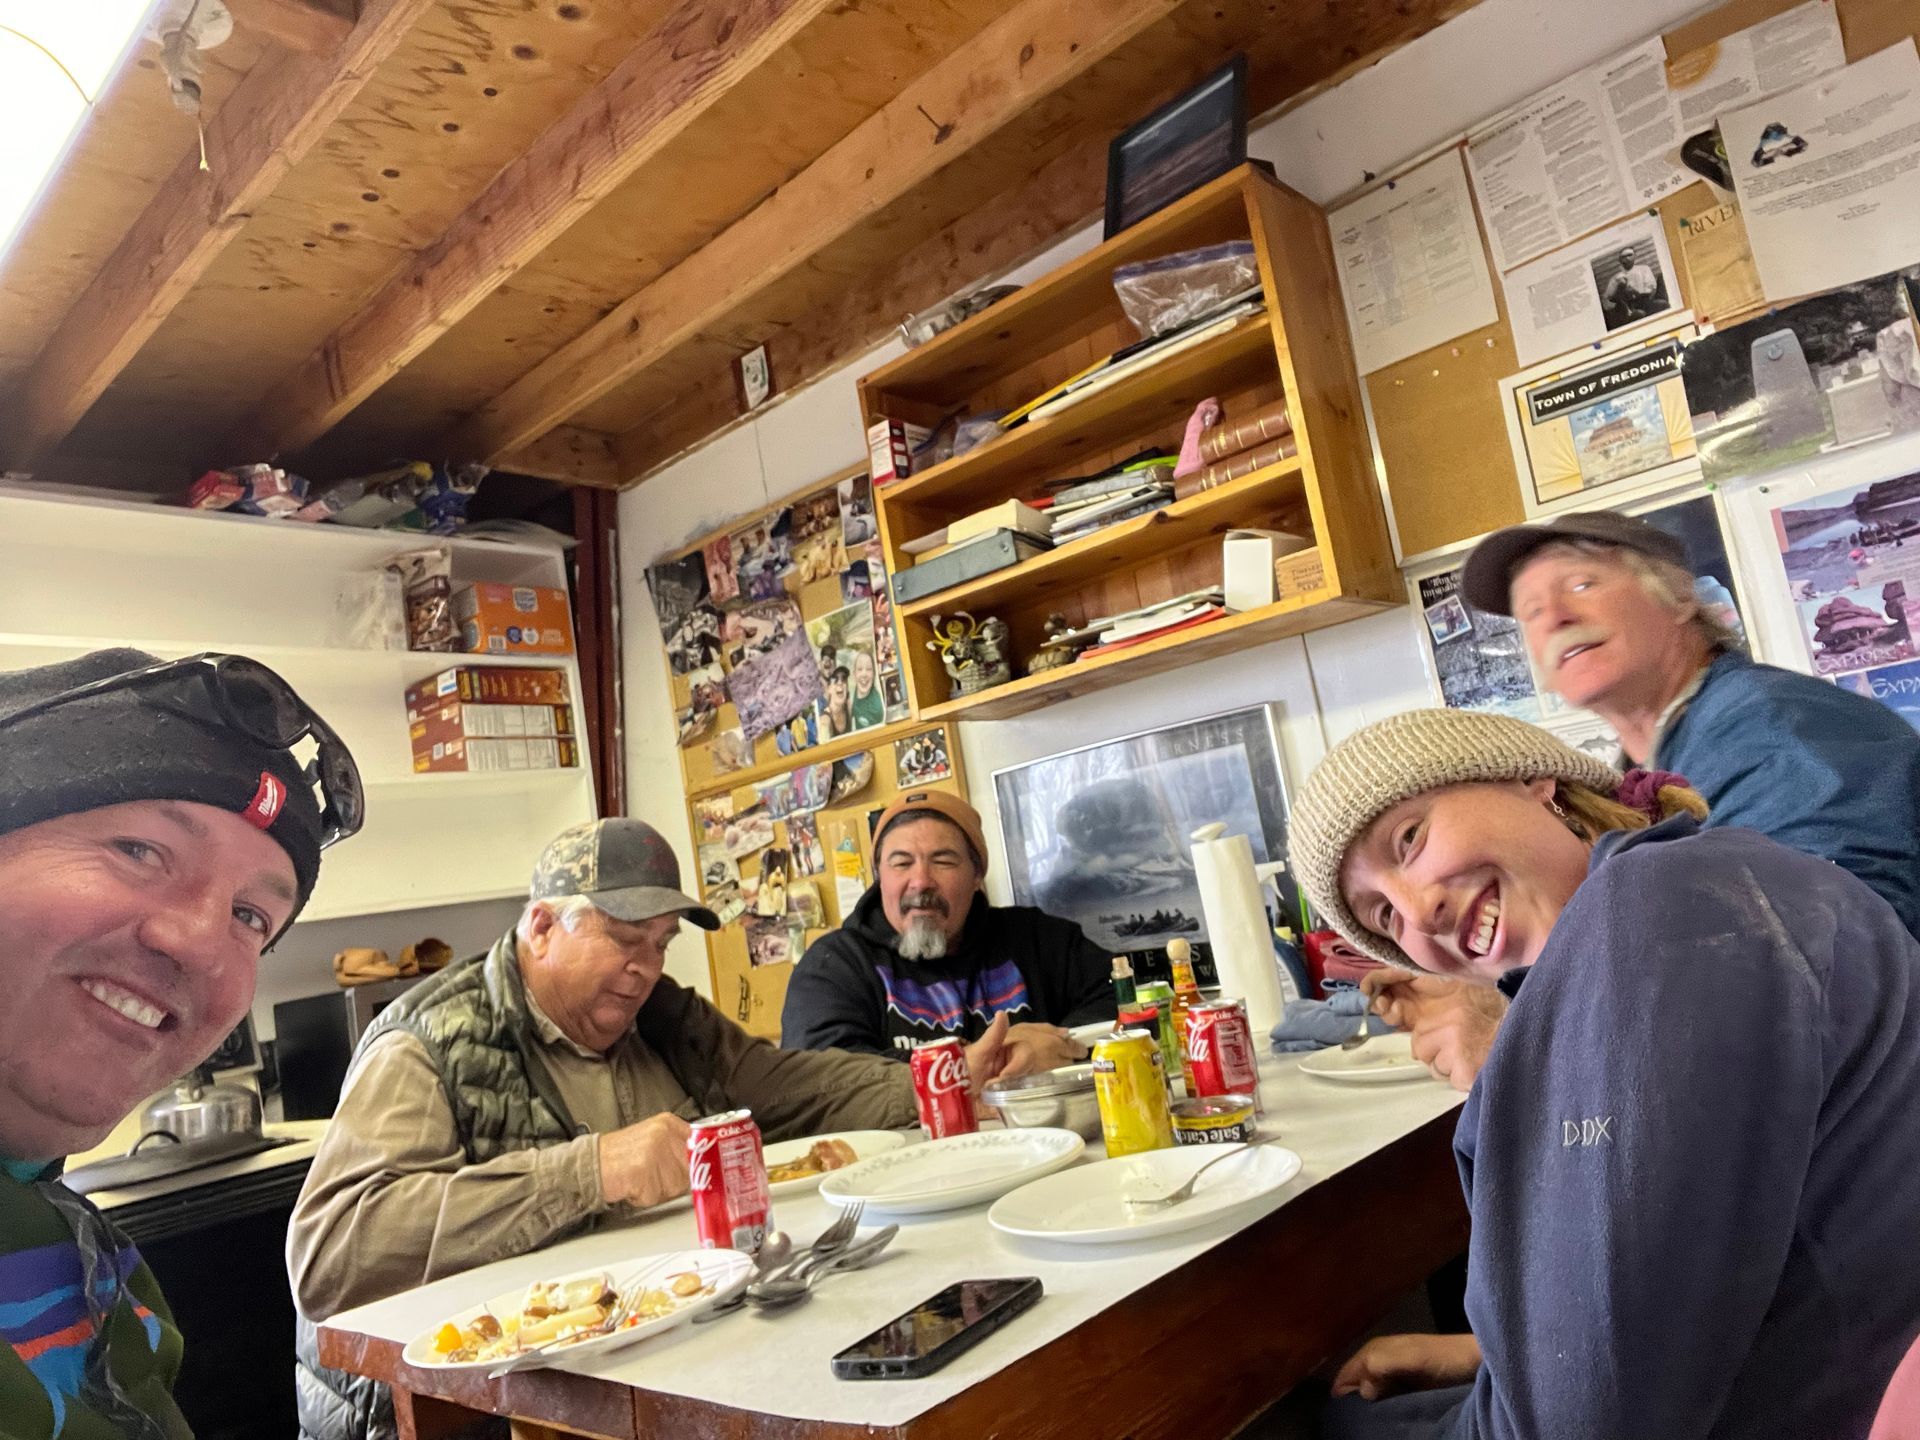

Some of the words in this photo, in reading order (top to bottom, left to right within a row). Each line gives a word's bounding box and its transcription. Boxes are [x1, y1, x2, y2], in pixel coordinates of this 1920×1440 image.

[1535, 389, 1575, 410] TOWN
[1578, 382, 1597, 396] OF
[1600, 355, 1676, 388] FREDONIA
[1210, 1124, 1241, 1143] Safe
[1562, 1115, 1613, 1147] DDX
